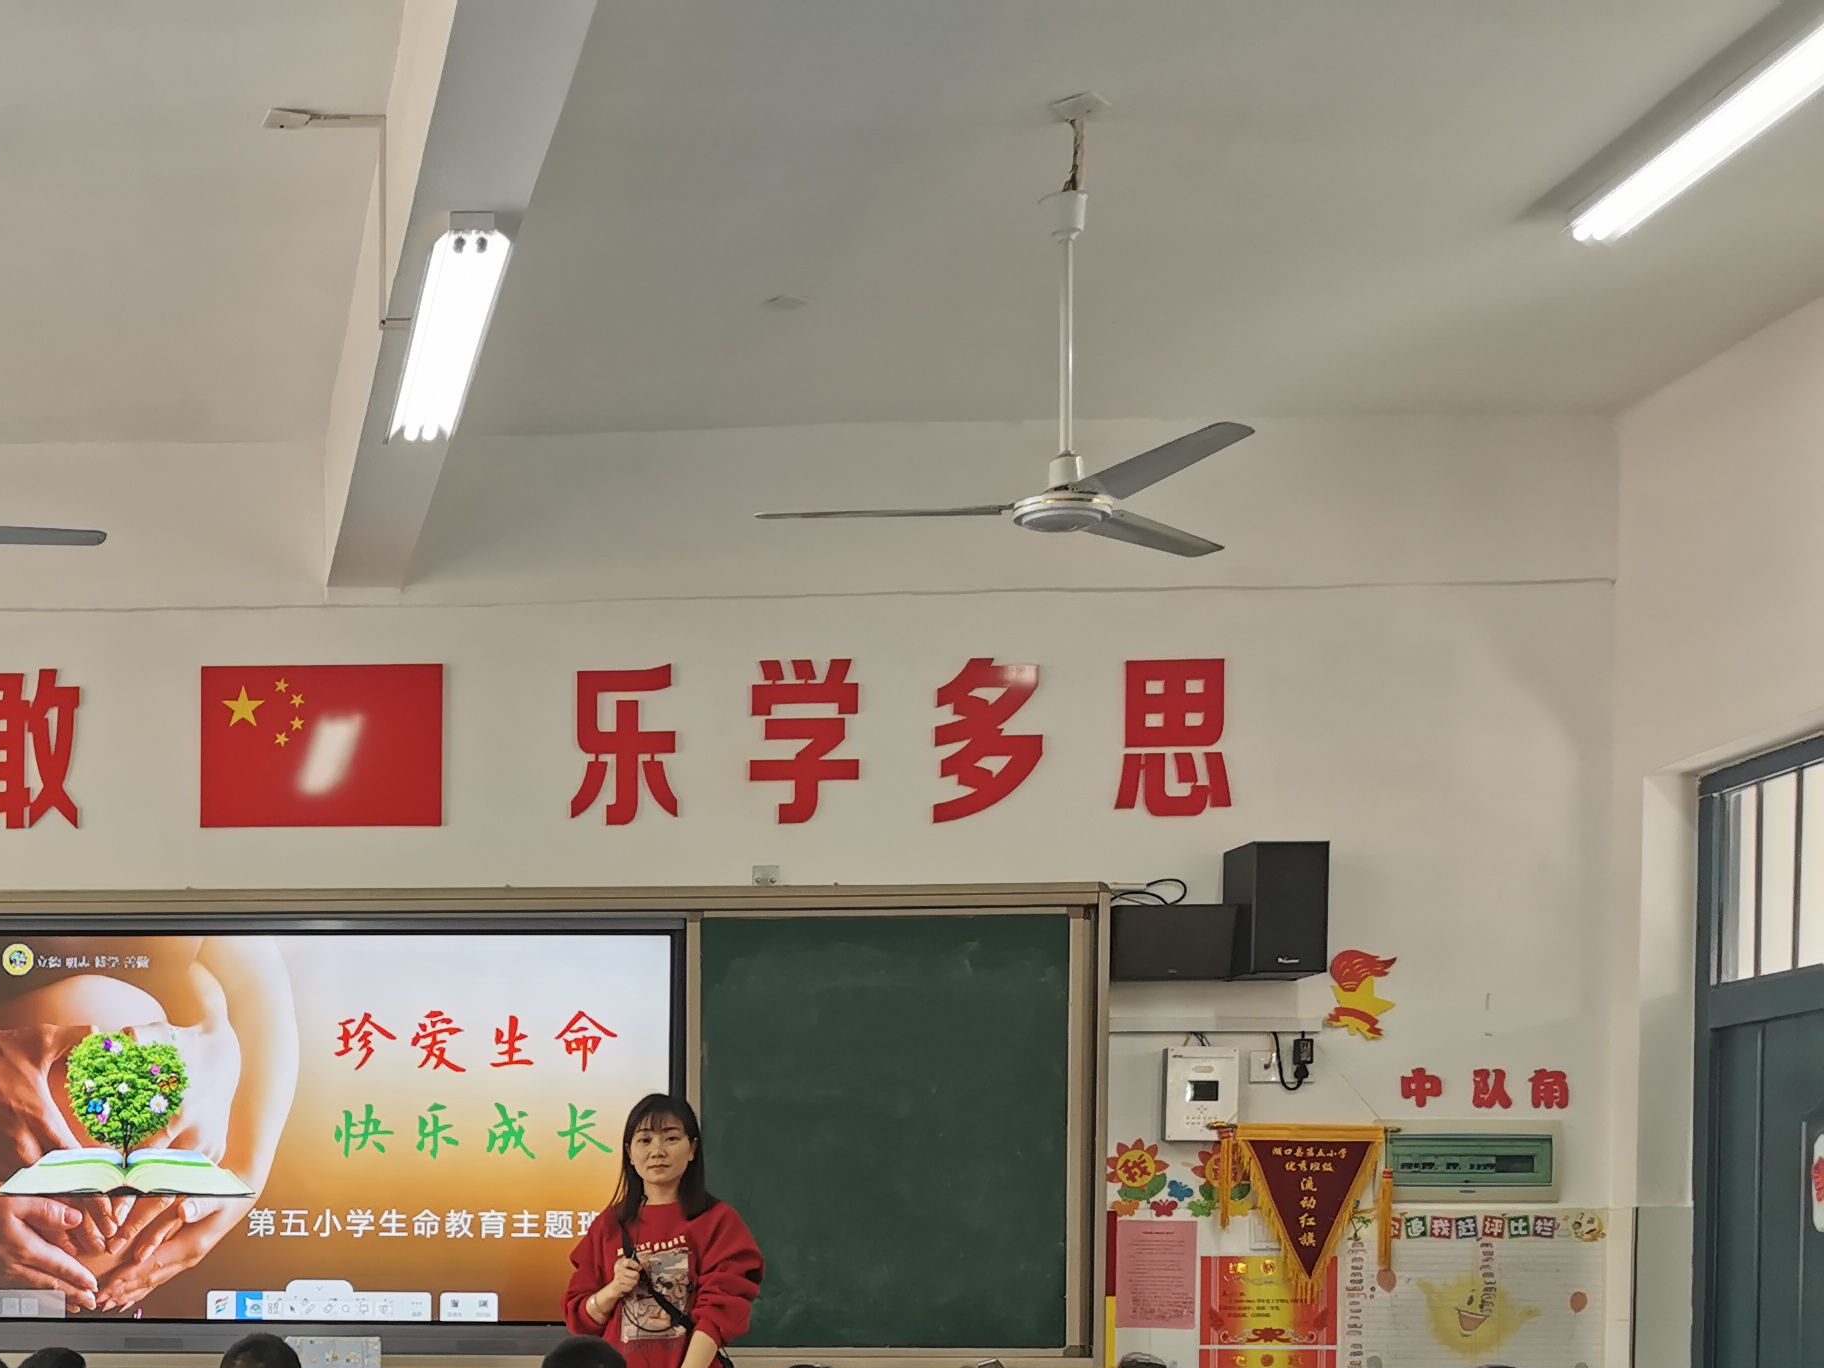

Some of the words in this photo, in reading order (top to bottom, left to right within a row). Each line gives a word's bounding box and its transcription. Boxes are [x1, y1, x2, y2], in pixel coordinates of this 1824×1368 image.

[571, 658, 1232, 825] 乐学多思
[334, 1010, 618, 1073] 珍爱生命
[1400, 1067, 1570, 1109] 中队角
[334, 1102, 614, 1160] 快乐成长
[1298, 1176, 1317, 1247] 流动红旗
